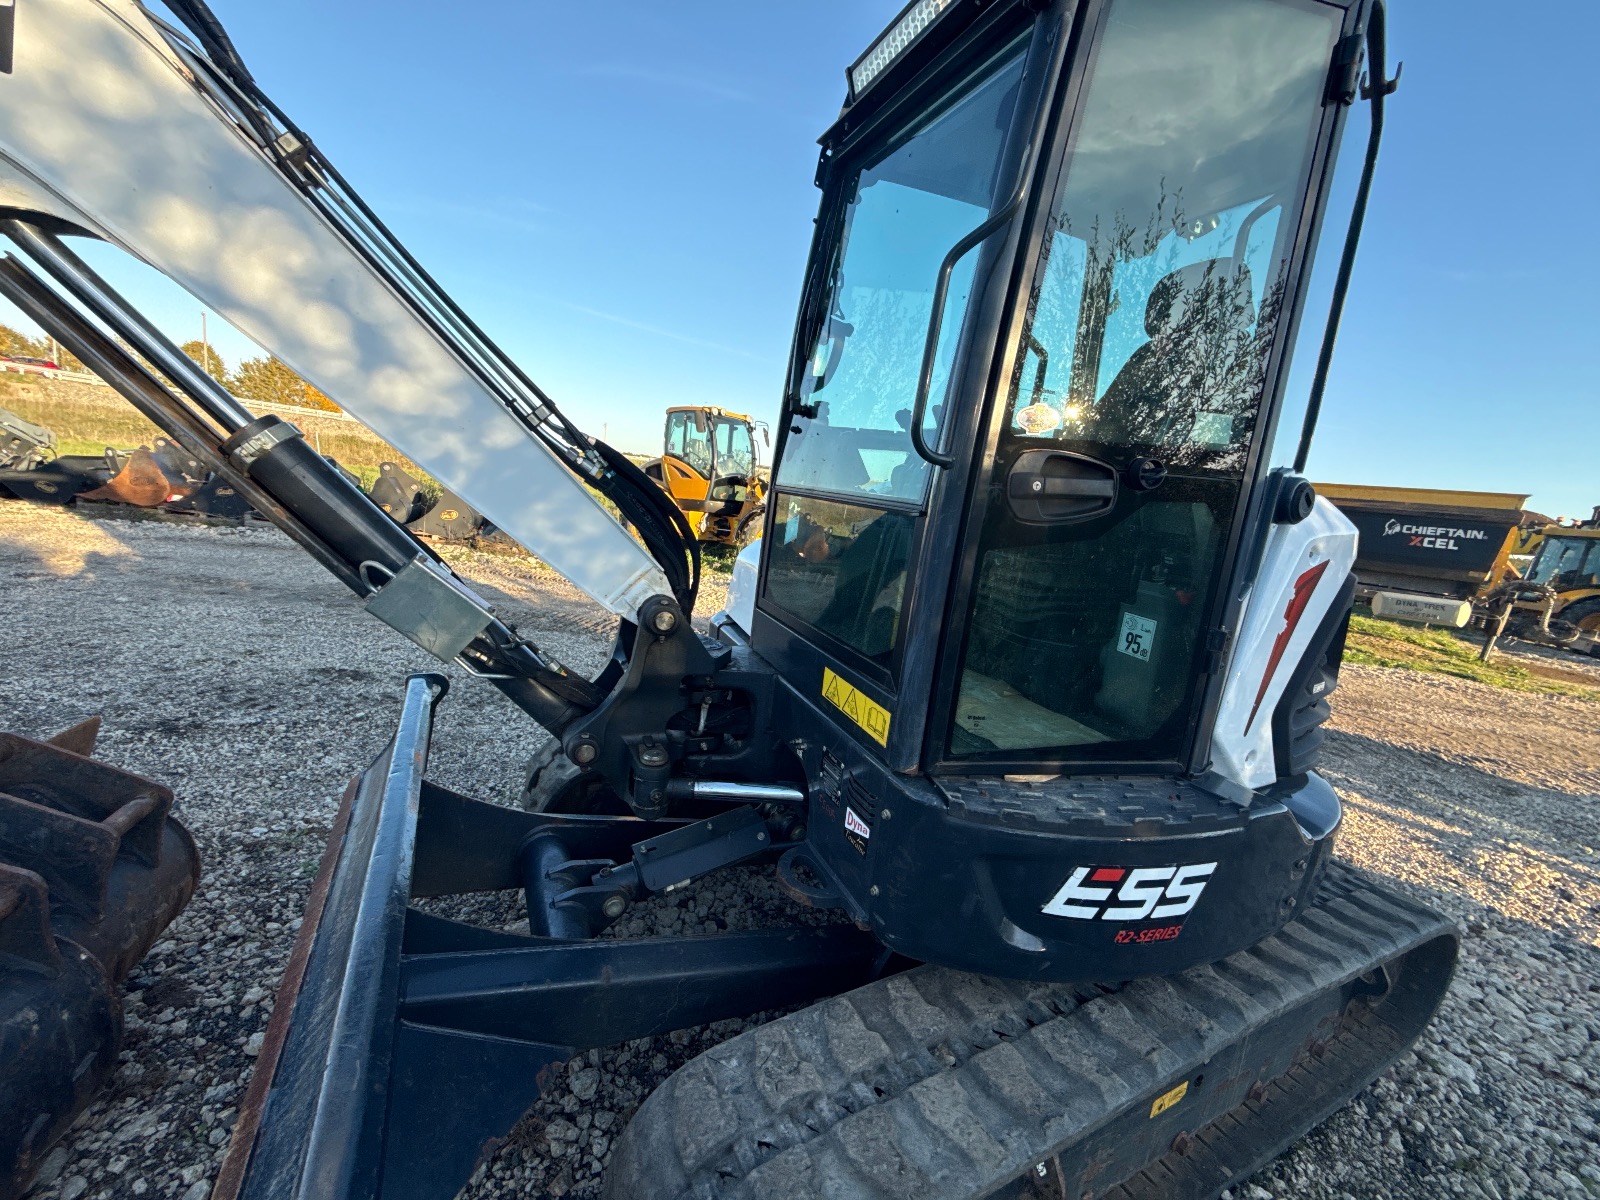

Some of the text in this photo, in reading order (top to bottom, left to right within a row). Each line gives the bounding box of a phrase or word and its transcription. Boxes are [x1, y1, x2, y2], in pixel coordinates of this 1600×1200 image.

[1402, 525, 1484, 539] CHIEFTAIN
[1408, 536, 1459, 550] XCEL
[1395, 599, 1418, 608] DYNA
[1125, 631, 1143, 655] 95
[846, 810, 869, 836] Dyna
[1114, 925, 1183, 946] R2-SERIES
